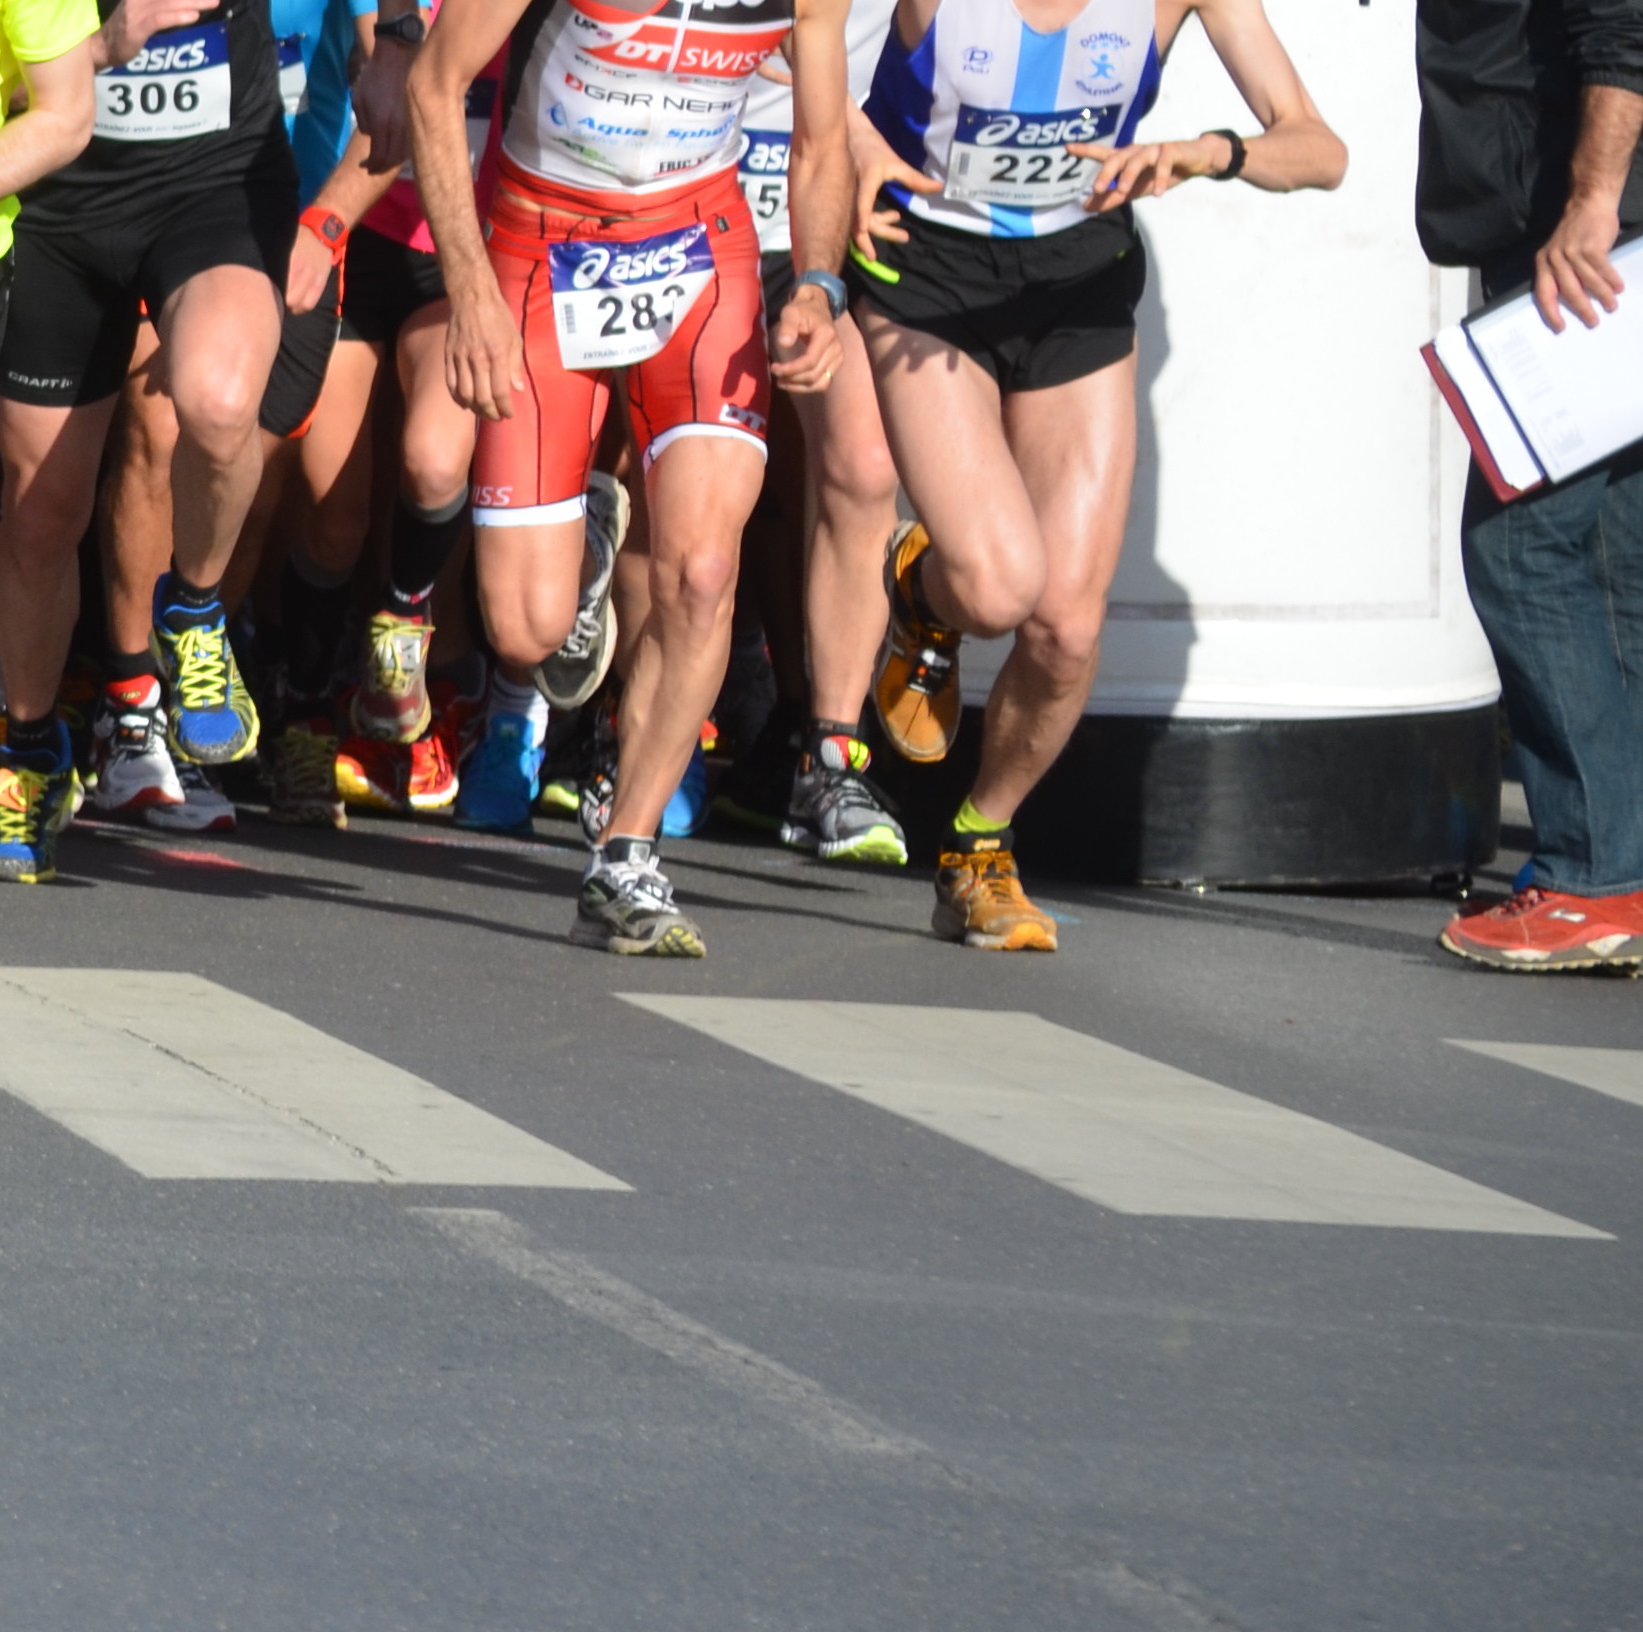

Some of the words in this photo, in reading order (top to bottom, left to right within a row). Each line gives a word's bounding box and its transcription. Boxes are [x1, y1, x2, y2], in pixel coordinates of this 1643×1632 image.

[615, 39, 673, 63] DT
[107, 79, 200, 116] 306
[577, 116, 649, 136] Aqua
[747, 141, 791, 172] asi
[989, 154, 1083, 184] 222
